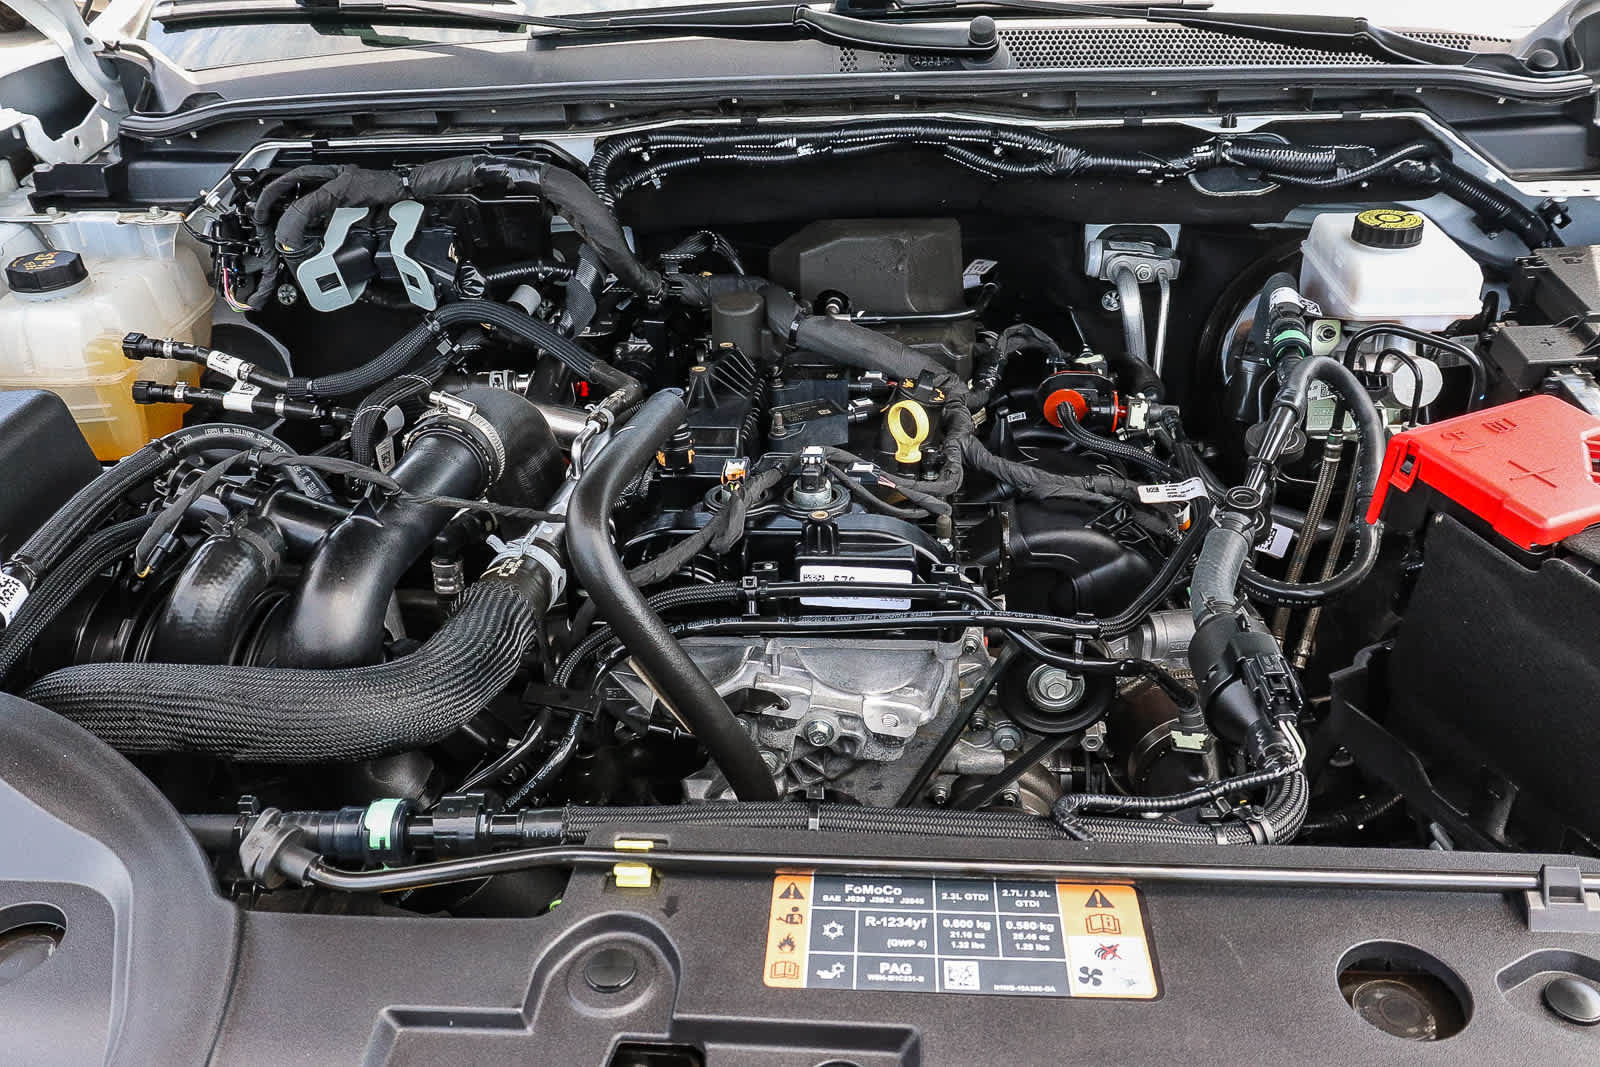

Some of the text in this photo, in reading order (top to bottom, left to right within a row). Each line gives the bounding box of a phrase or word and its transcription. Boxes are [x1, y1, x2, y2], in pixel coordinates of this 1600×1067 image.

[844, 883, 903, 896] FoMoCo
[1001, 889, 1023, 897] 2.7L
[822, 894, 842, 902] SAE
[942, 892, 989, 901] 2.3L GTDI
[1015, 900, 1040, 908] GTDI
[865, 916, 928, 931] R-1234yf
[976, 919, 992, 931] kg
[1039, 922, 1055, 933] kg
[971, 941, 986, 949] lbs
[1035, 943, 1051, 951] lbs
[879, 961, 913, 975] PAG
